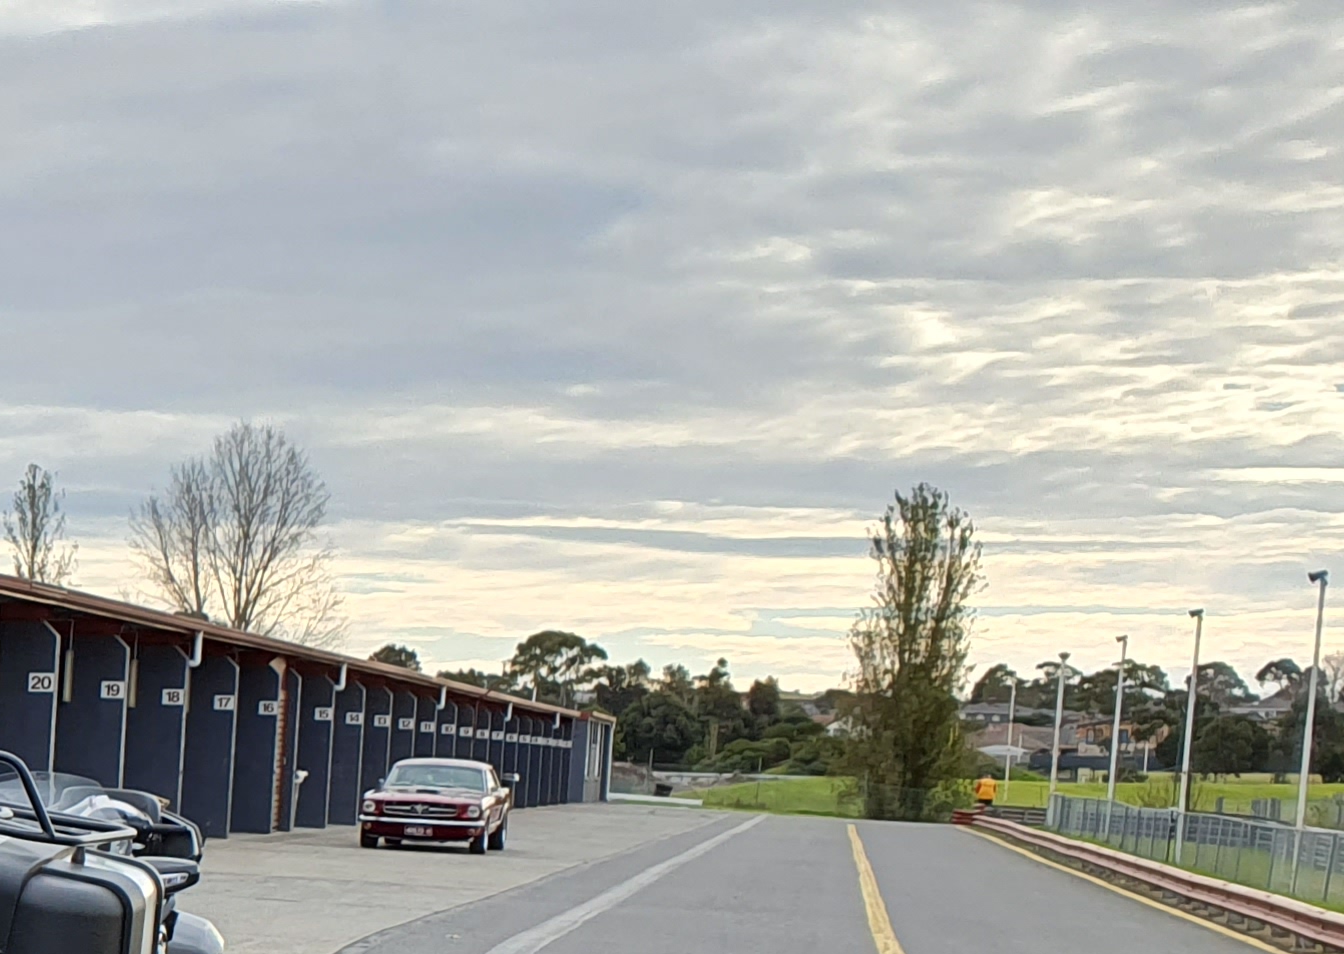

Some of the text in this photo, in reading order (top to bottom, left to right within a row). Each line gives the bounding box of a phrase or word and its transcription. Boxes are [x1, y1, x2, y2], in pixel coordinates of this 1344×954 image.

[30, 675, 52, 690] 20
[104, 683, 120, 697] 19
[165, 691, 180, 703] 18
[217, 697, 231, 708] 17
[262, 702, 274, 713] 16
[318, 709, 328, 719] 15
[349, 714, 359, 722] 14
[377, 716, 387, 725] 13
[402, 720, 410, 728] 12
